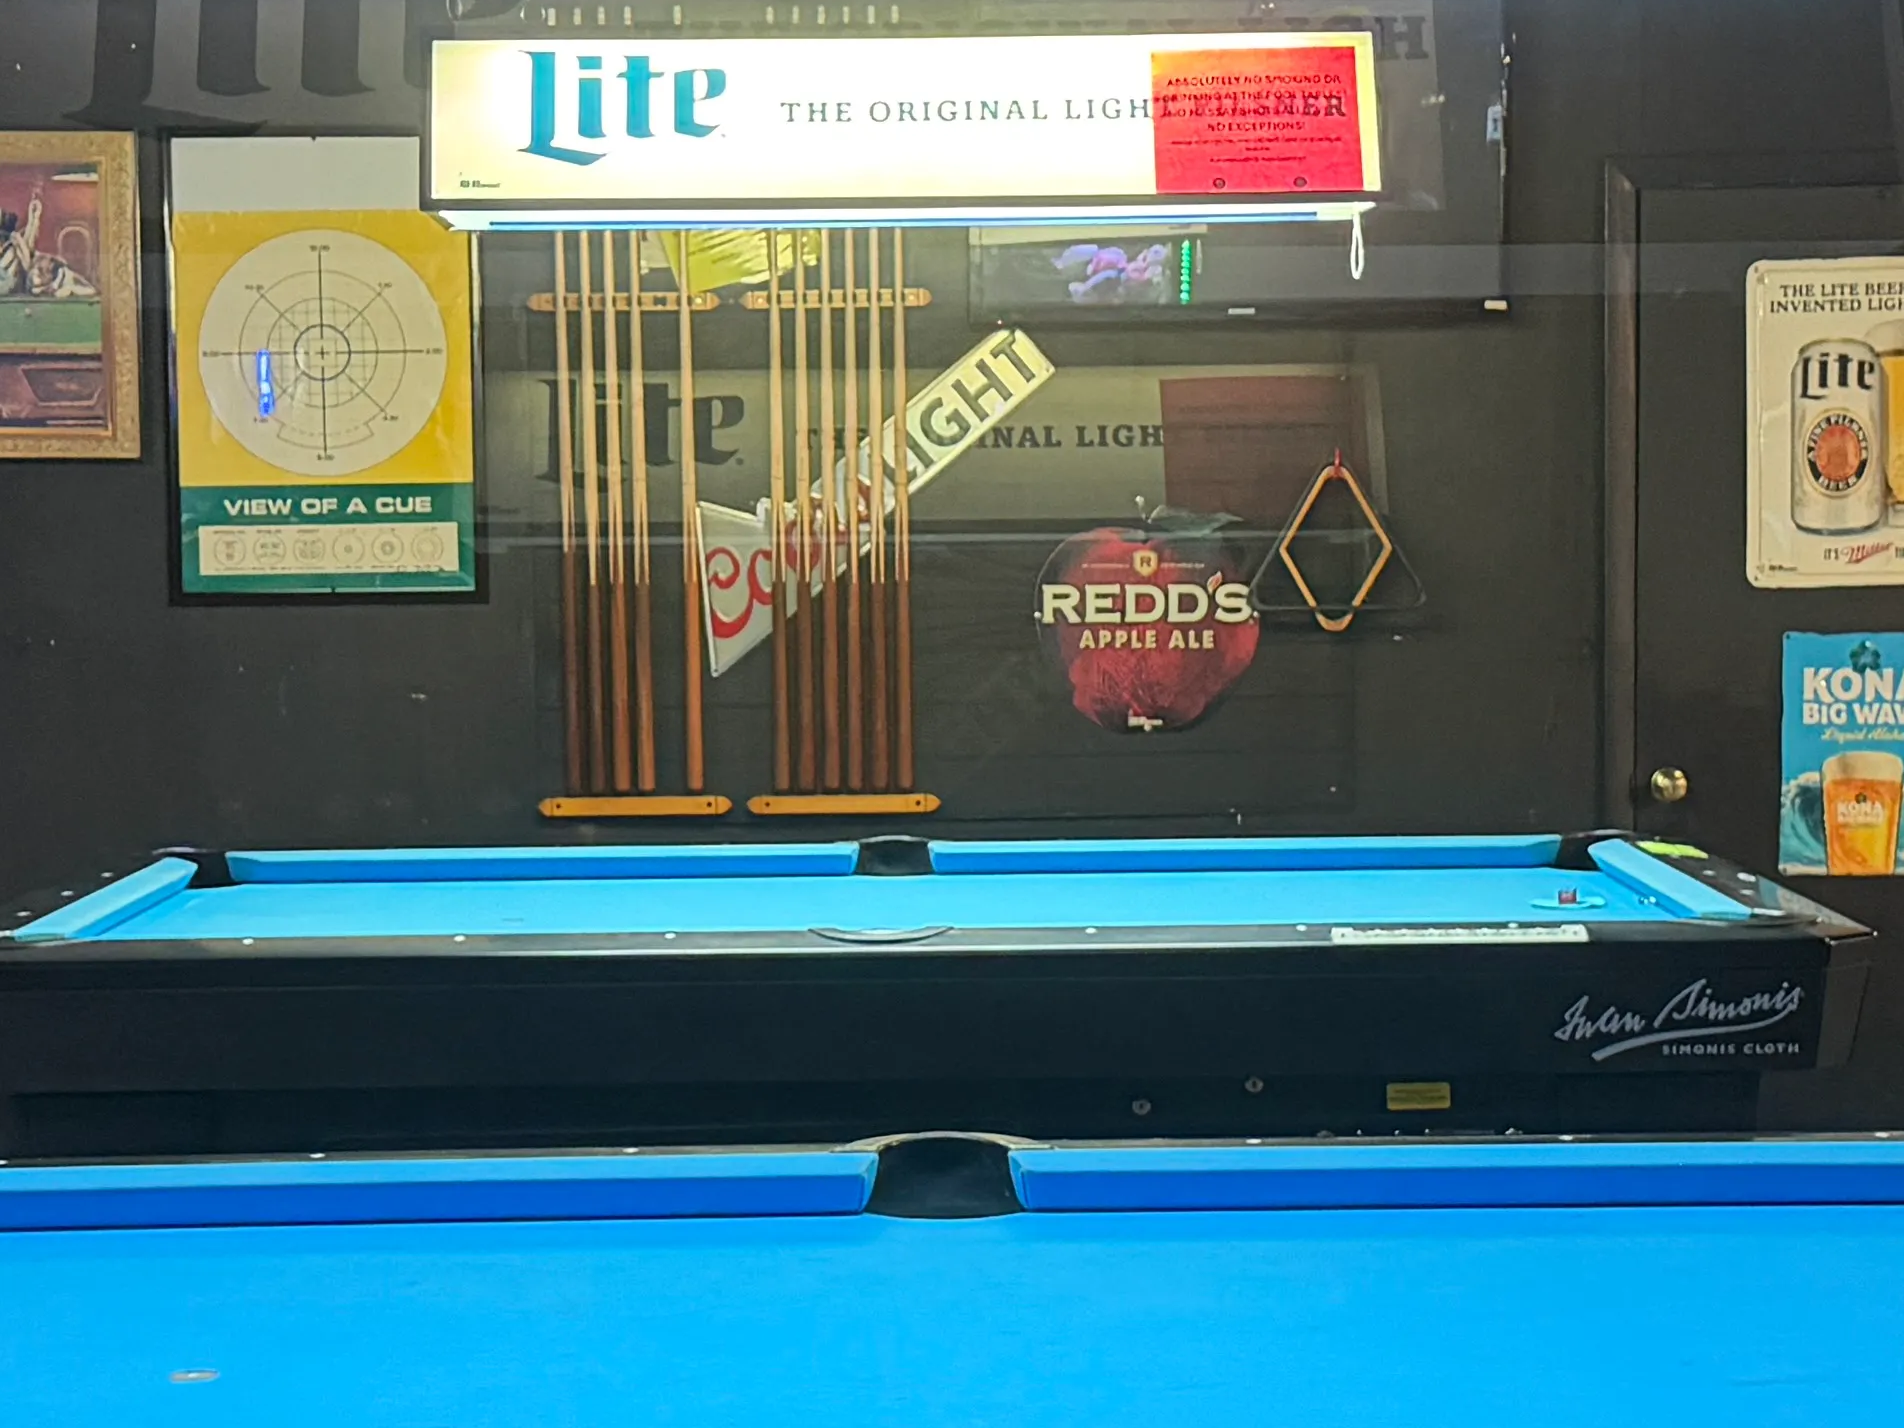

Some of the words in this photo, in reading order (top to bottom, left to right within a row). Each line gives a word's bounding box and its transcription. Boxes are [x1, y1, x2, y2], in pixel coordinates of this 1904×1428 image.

[517, 49, 728, 167] Lite
[780, 100, 853, 124] THE
[868, 98, 1049, 123] ORIGINAL
[1780, 284, 1816, 298] THE
[1820, 283, 1860, 297] LITE
[1769, 299, 1862, 313] INVENTED
[1799, 352, 1876, 401] Lite
[1076, 424, 1167, 448] LIGH
[223, 498, 293, 516] VIEW
[300, 497, 339, 515] OF
[346, 497, 368, 514] A
[374, 495, 433, 513] CUE
[1041, 572, 1254, 624] REDD'S
[1078, 628, 1158, 650] APPLE
[1167, 628, 1215, 650] ALE
[1802, 702, 1848, 726] BIG
[1652, 977, 1802, 1029] Simonis
[1661, 1043, 1737, 1056] SIMONIS
[1743, 1042, 1800, 1055] CLOTH
